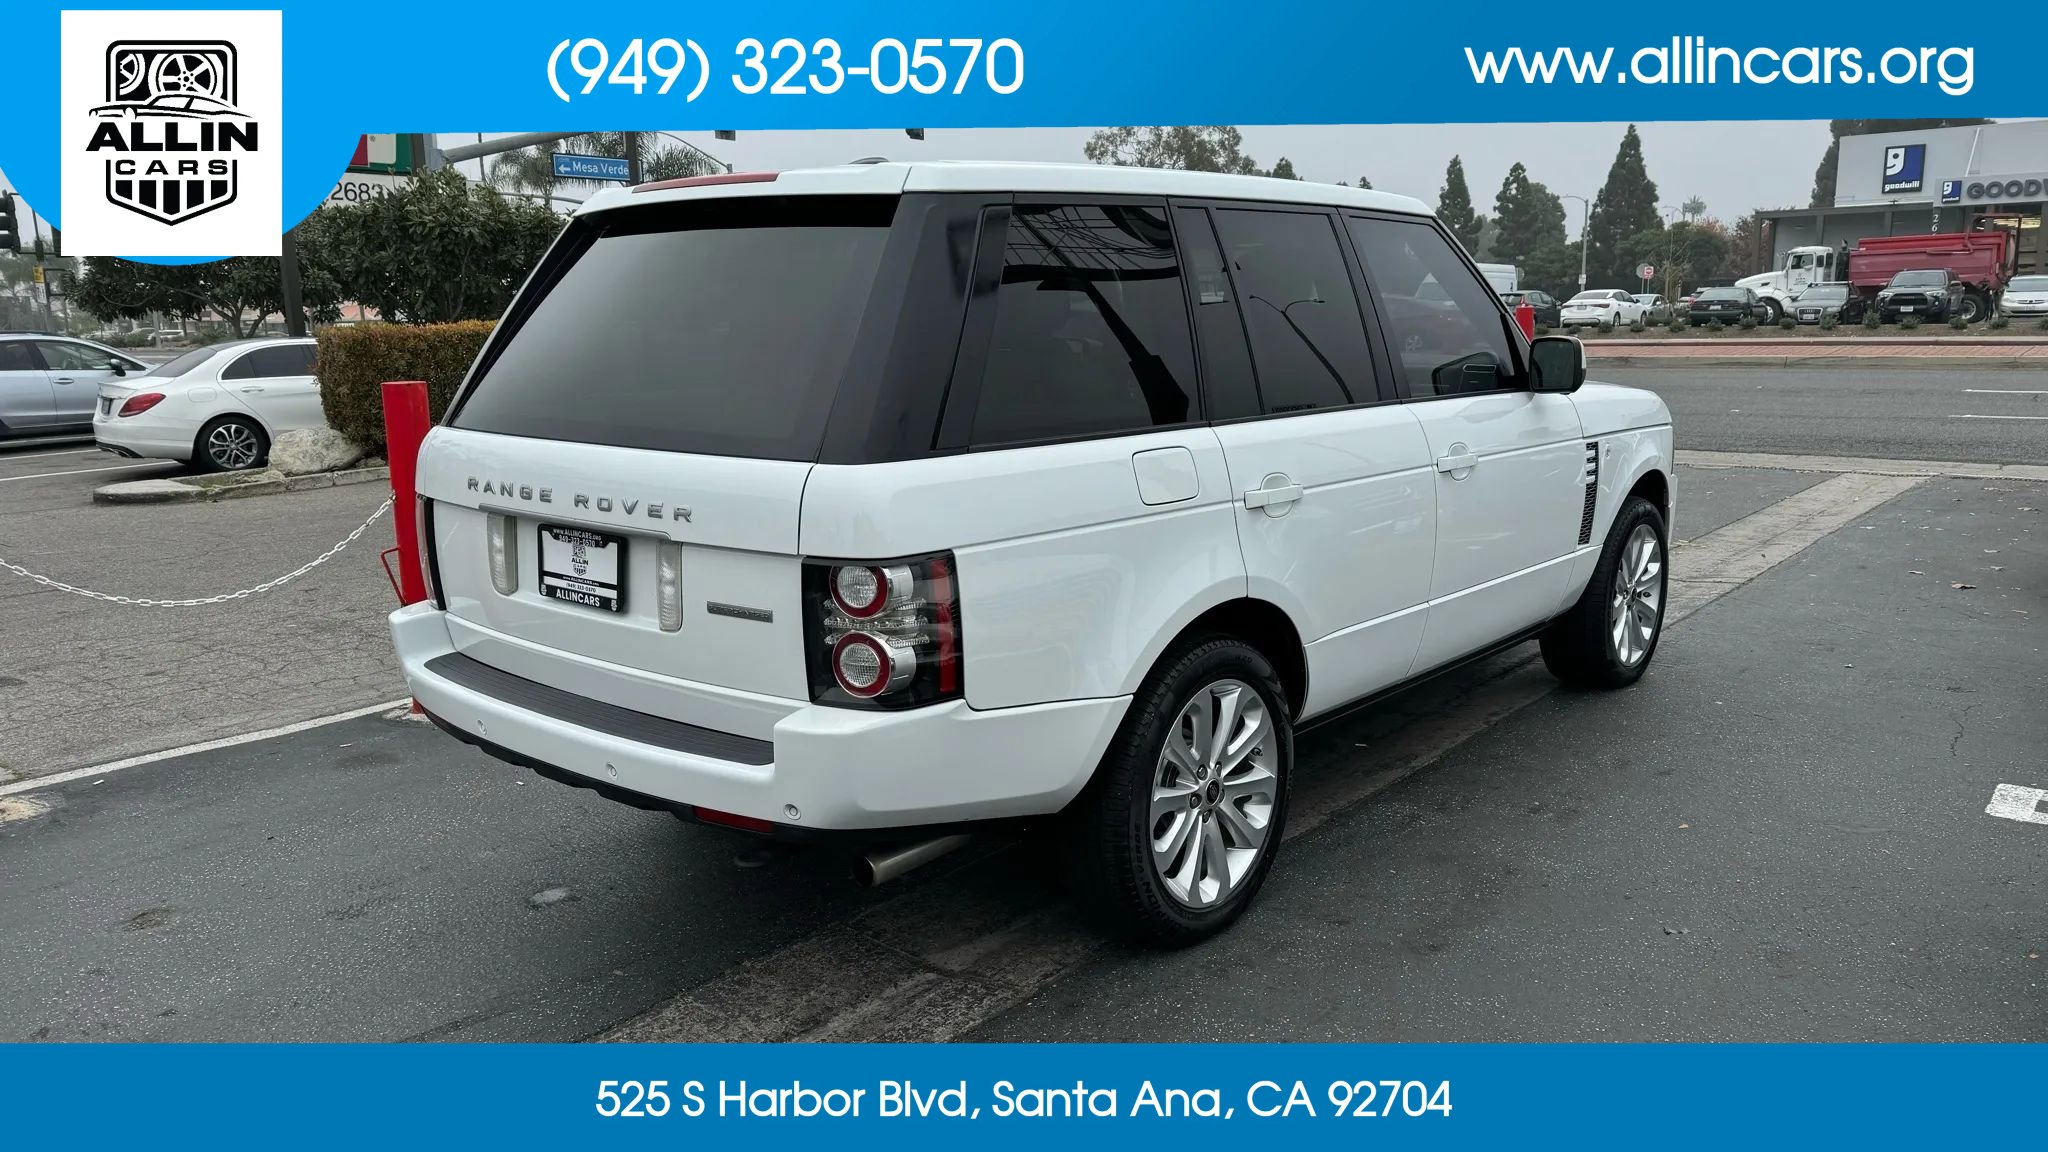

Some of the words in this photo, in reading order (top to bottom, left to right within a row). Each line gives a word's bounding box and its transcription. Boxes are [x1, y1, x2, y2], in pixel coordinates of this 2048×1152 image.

[572, 161, 598, 173] Mesa
[600, 162, 629, 175] Verde
[1884, 180, 1920, 192] goodwill
[1967, 178, 2048, 200] GOOD
[467, 476, 553, 503] RANGE
[574, 492, 693, 522] ROVER
[556, 588, 600, 607] ALLINCARS
